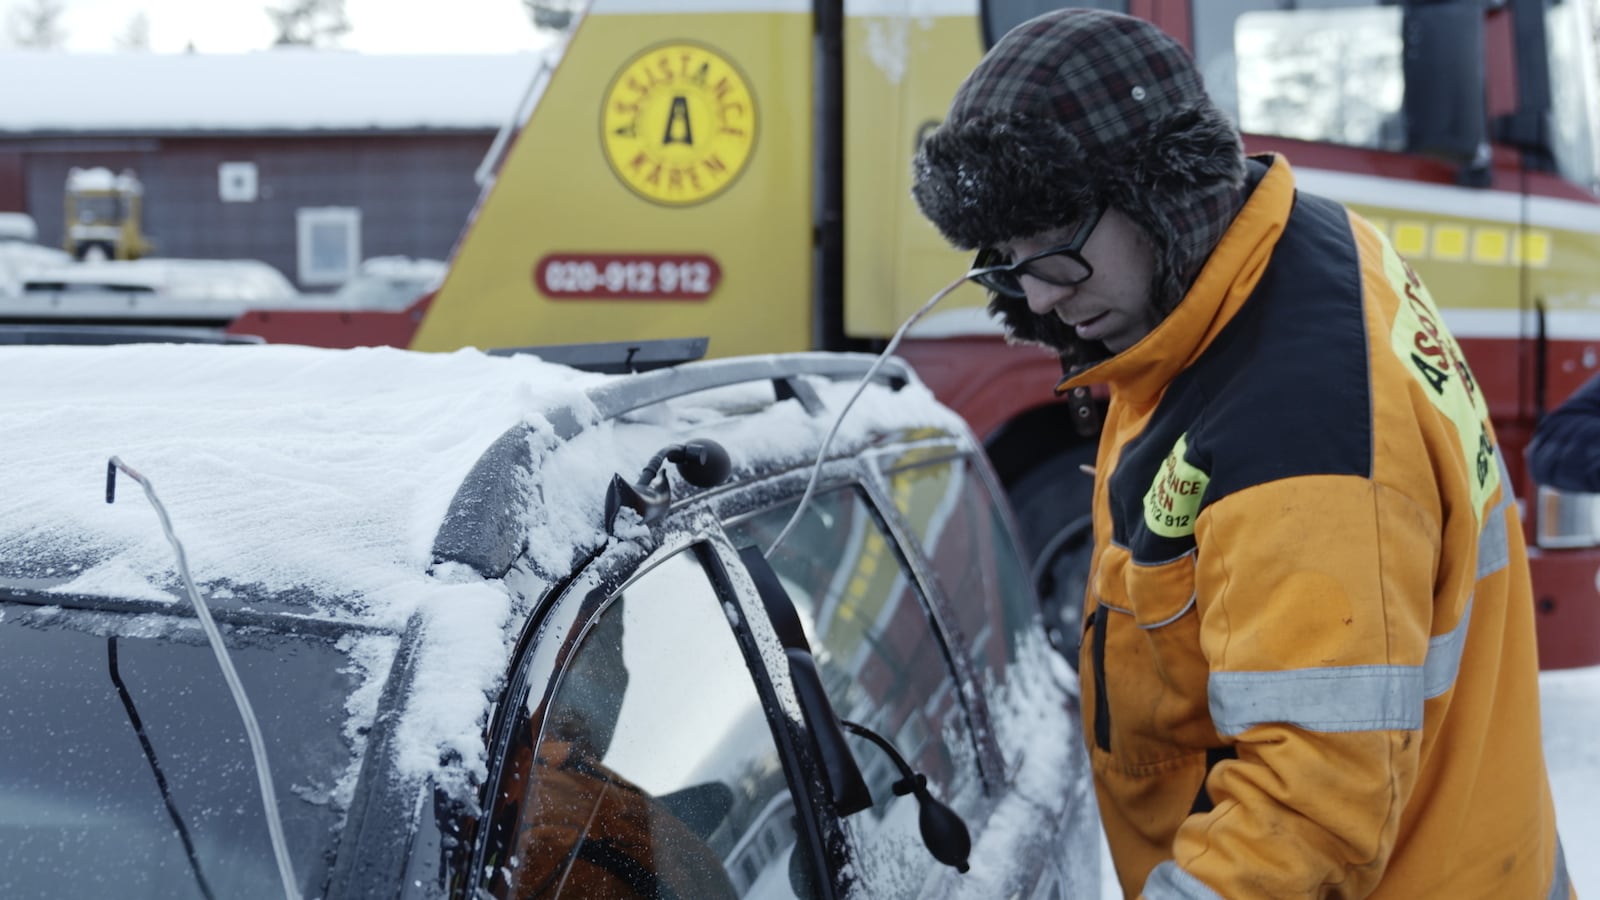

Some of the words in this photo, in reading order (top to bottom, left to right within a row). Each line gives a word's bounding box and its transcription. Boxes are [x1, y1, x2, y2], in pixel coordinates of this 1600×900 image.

[613, 53, 744, 138] ASSISTANCE
[545, 261, 656, 292] 020-912
[658, 262, 711, 293] 912
[1165, 514, 1190, 528] 912
